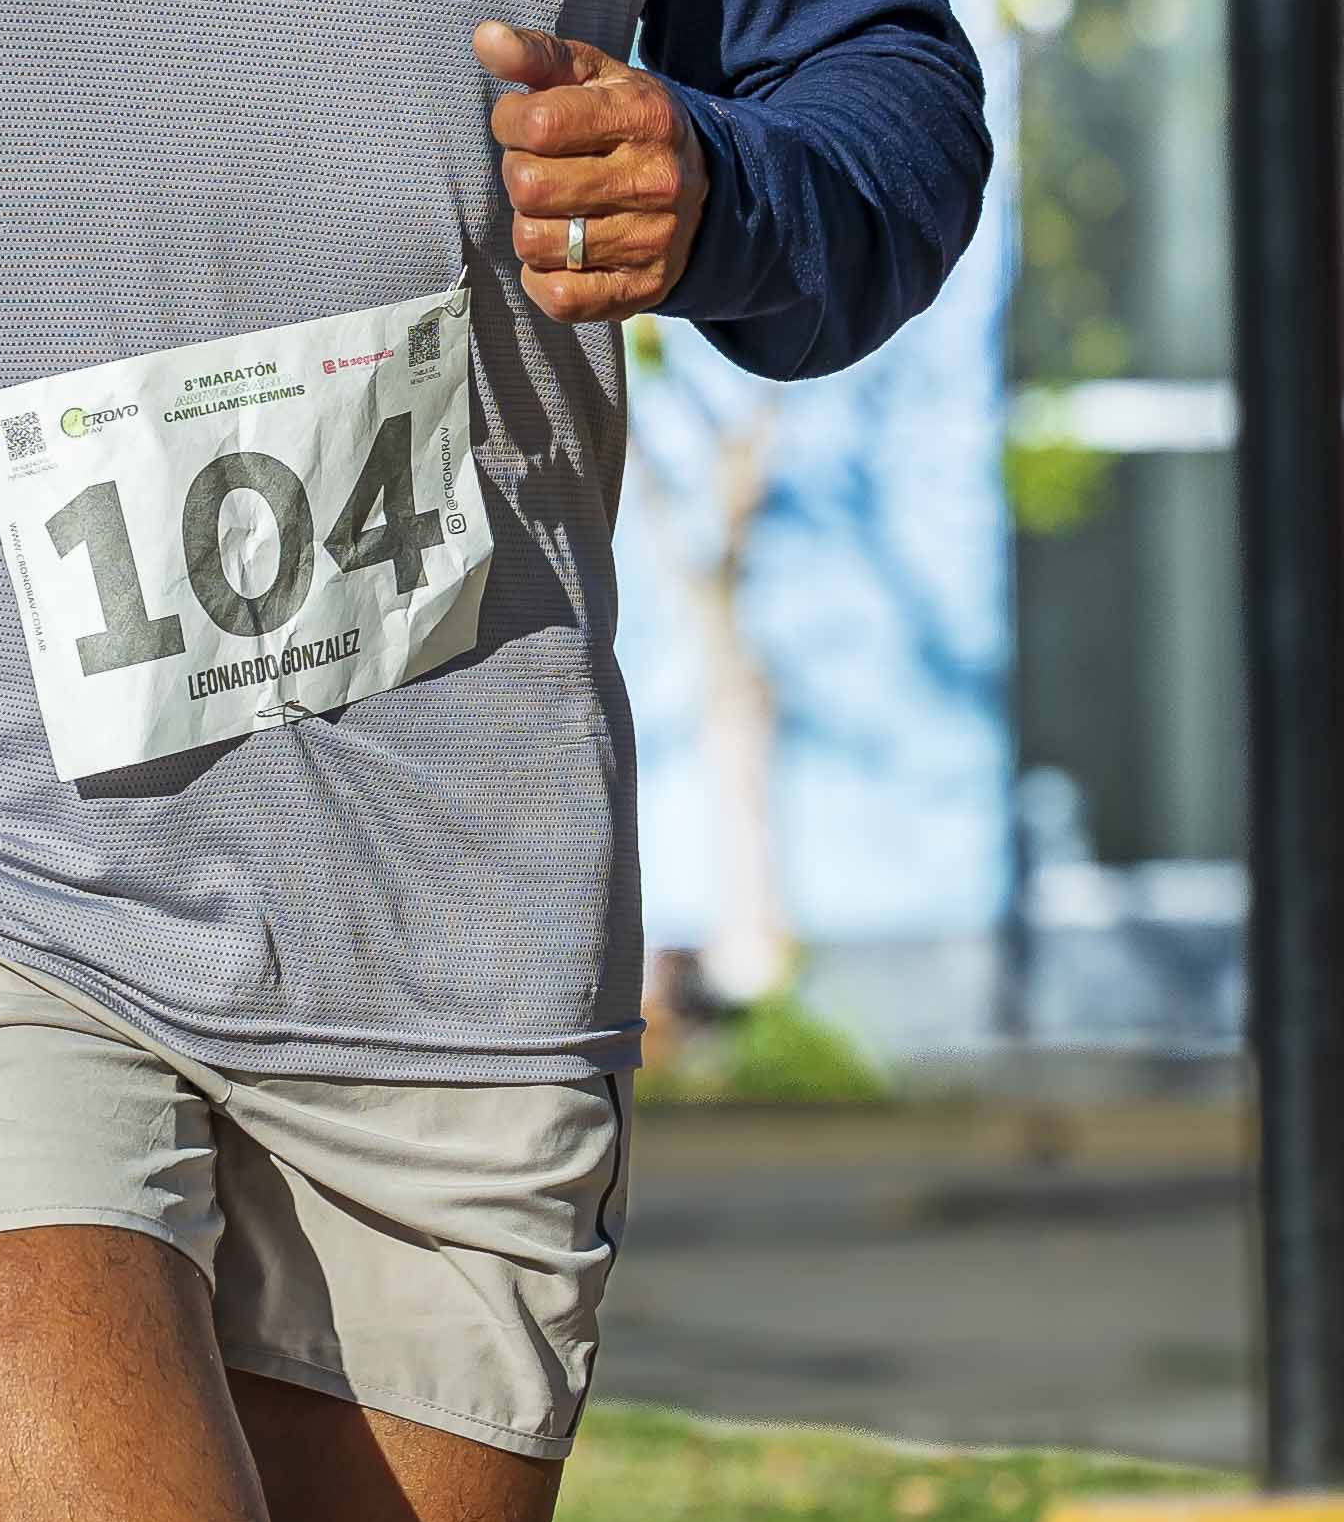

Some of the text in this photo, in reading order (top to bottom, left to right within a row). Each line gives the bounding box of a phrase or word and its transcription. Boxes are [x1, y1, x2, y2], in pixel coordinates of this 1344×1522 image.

[163, 384, 306, 423] CAWILLIAMSKEMMIS
[440, 427, 459, 511] @CRONORAV
[45, 411, 445, 677] 104
[187, 627, 361, 701] LEONARDO GONZALEZ
